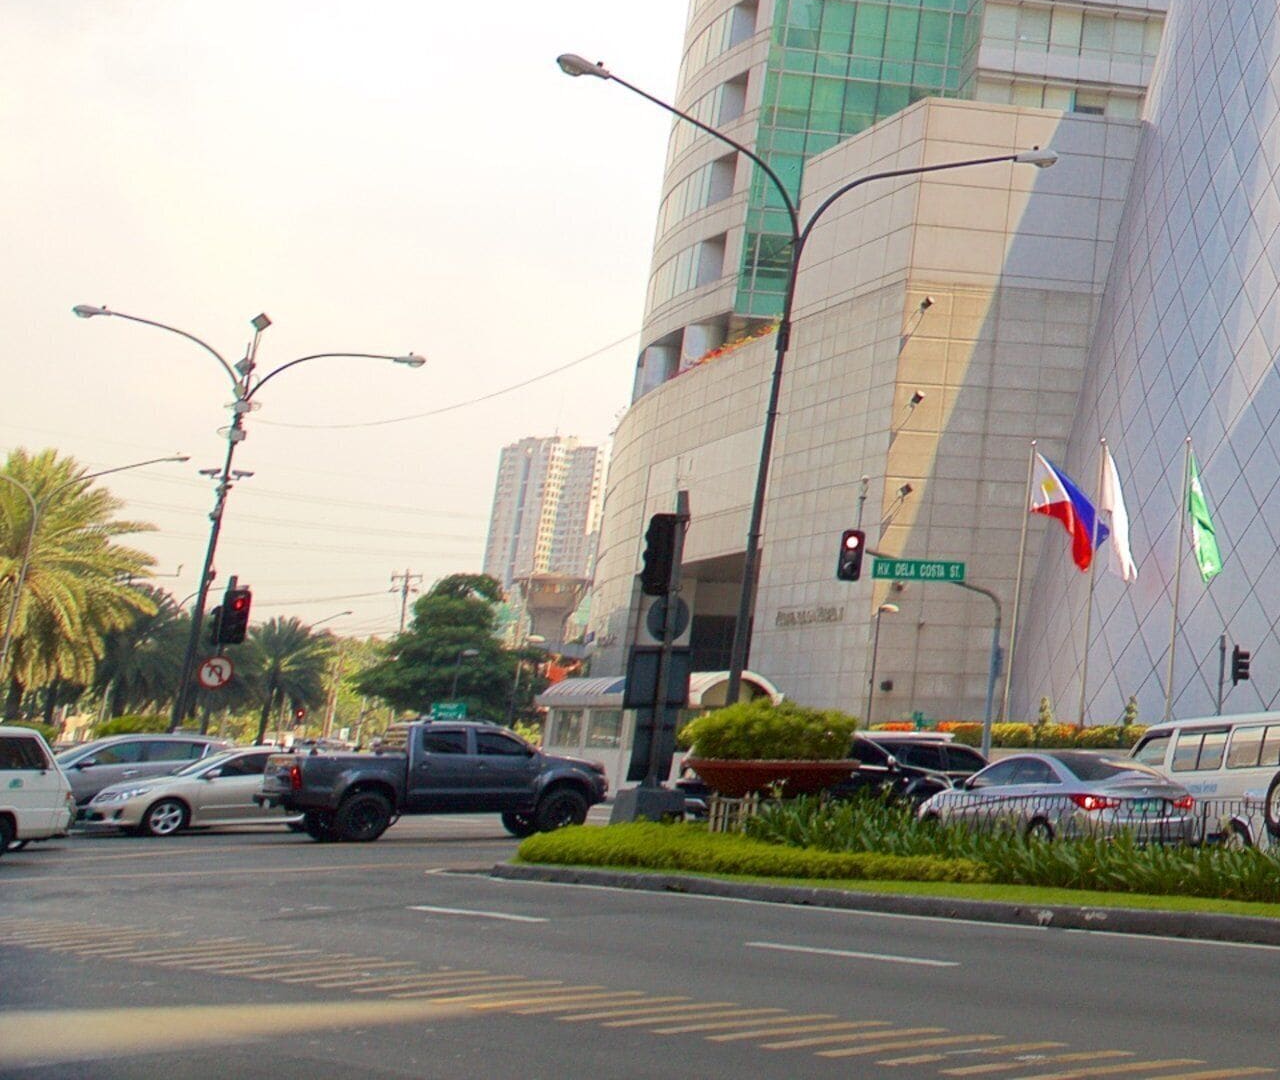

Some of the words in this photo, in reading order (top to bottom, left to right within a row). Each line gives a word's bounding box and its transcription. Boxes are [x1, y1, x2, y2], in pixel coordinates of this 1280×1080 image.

[895, 563, 915, 577] DELA
[920, 564, 945, 578] COSTA
[950, 565, 961, 578] ST.
